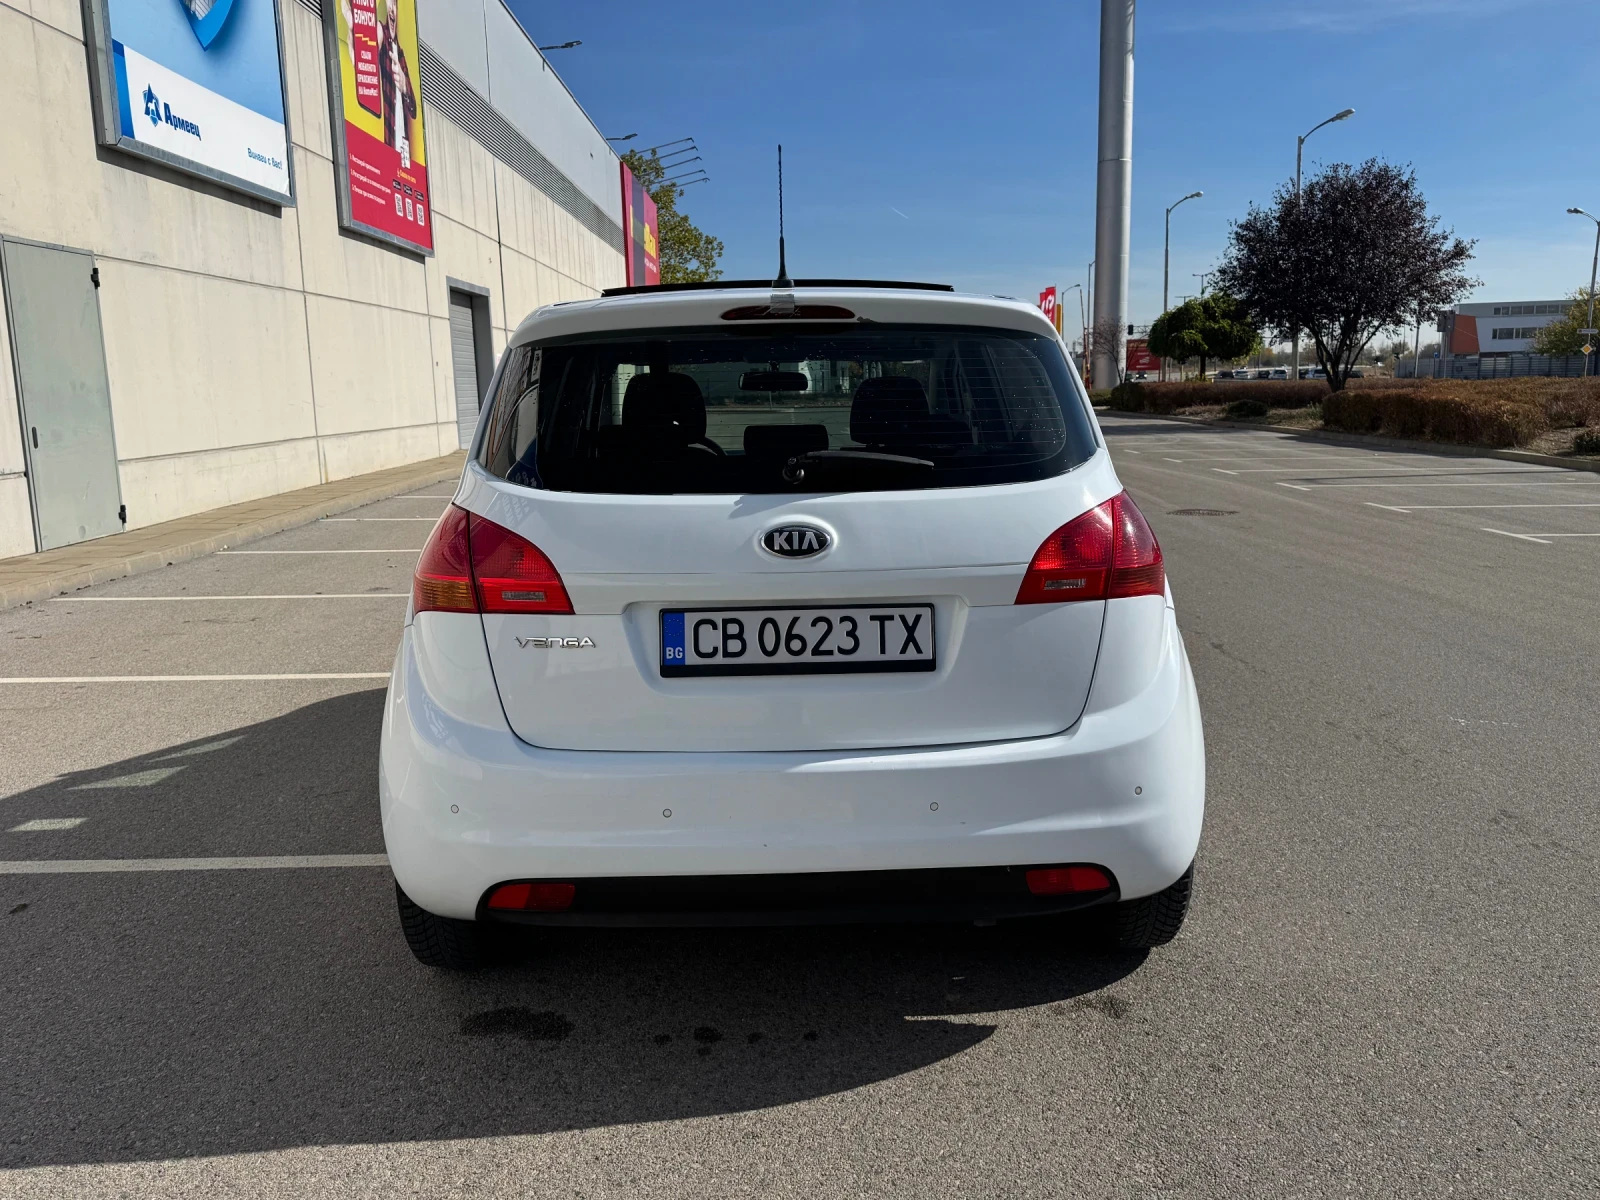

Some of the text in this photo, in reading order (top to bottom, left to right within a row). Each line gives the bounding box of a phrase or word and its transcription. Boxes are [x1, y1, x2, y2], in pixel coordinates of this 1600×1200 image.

[354, 8, 376, 27] БОНУСИ
[163, 102, 202, 141] Армеец
[773, 531, 820, 551] KIA
[514, 636, 596, 649] VENGA
[693, 614, 923, 659] CB 0623 TX
[665, 646, 683, 660] BG
